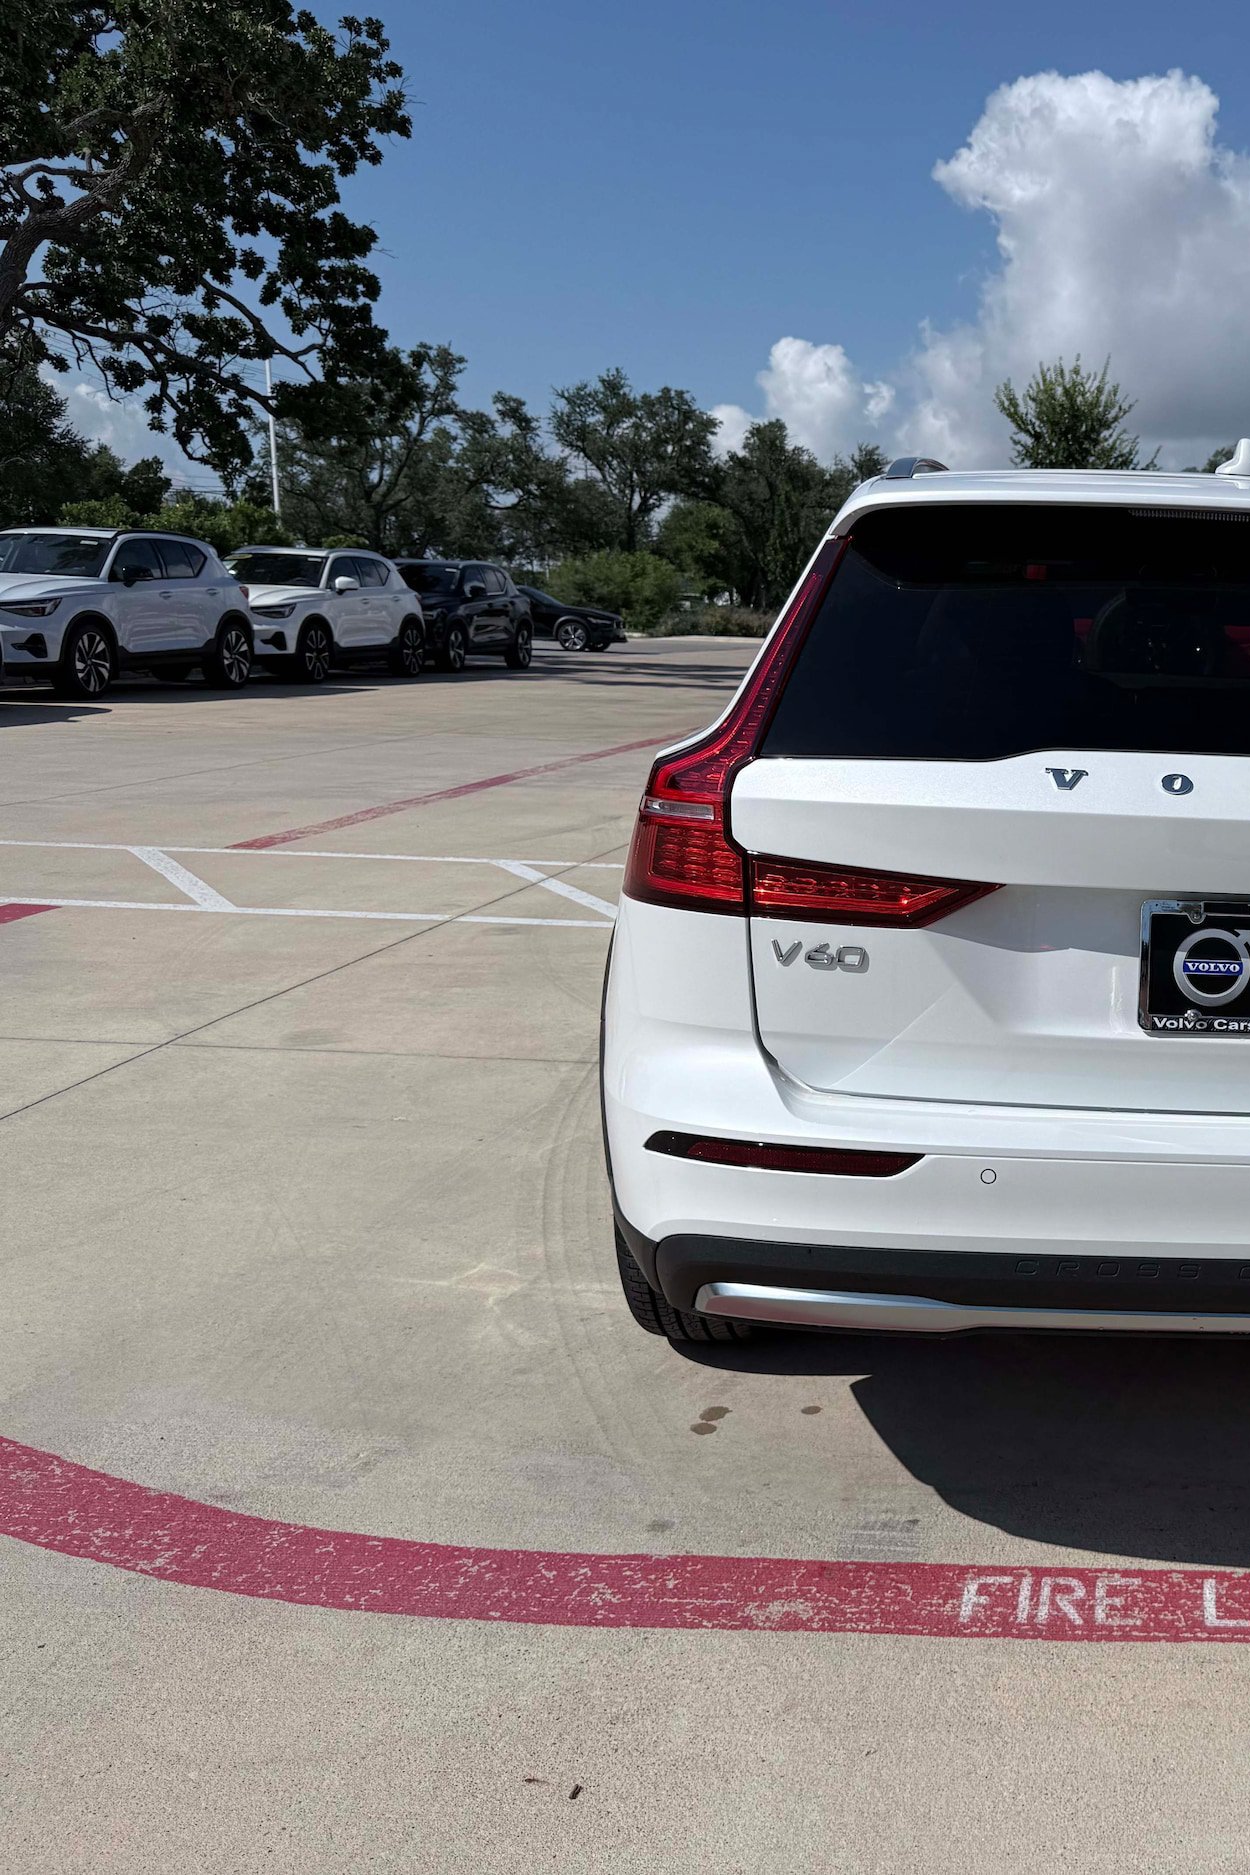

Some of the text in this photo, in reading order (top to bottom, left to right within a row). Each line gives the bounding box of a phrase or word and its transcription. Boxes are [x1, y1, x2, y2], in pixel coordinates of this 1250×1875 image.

[771, 939, 870, 973] V60
[1185, 961, 1240, 973] VOLVO
[1153, 1017, 1208, 1030] Volvo
[1014, 1259, 1200, 1280] CROSS
[958, 1574, 1142, 1628] FIRE
